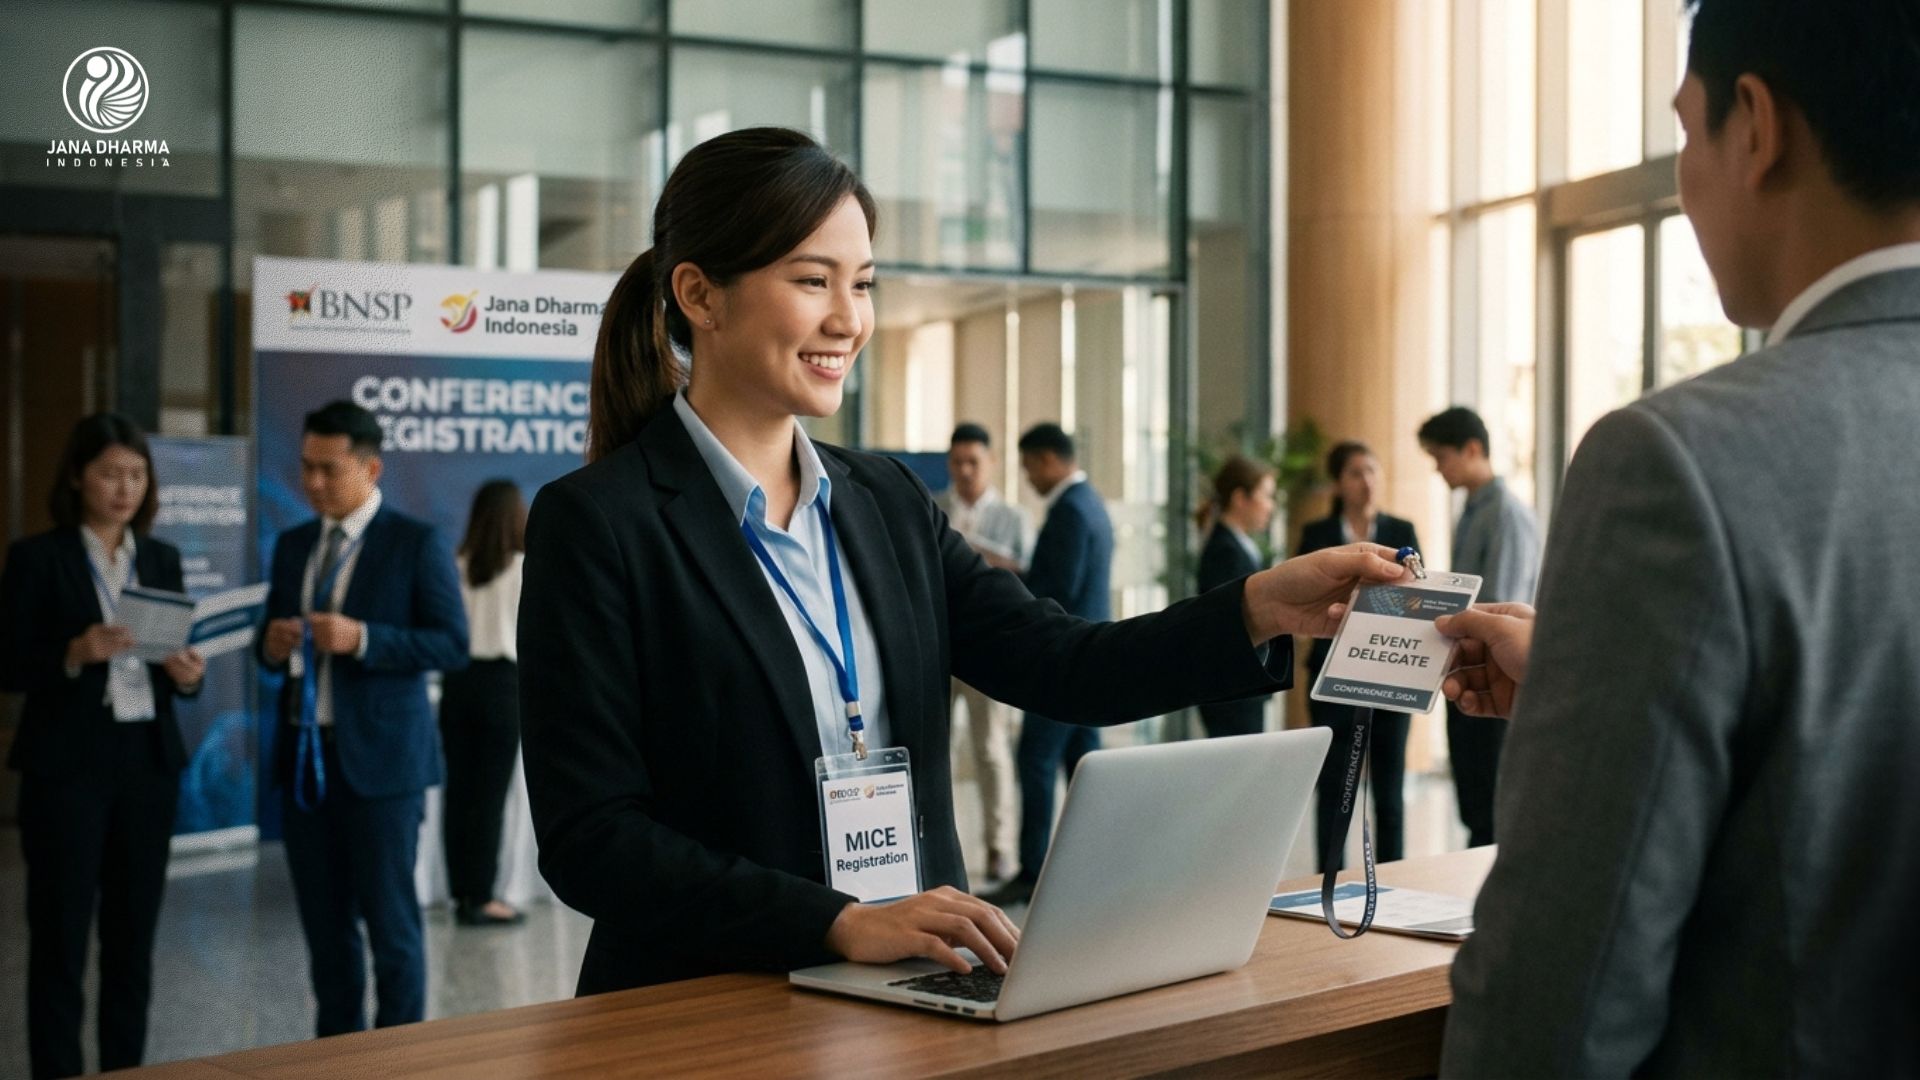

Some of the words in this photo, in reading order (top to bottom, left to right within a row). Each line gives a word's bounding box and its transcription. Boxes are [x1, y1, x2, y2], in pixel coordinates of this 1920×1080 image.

[321, 290, 413, 320] BNSP
[485, 296, 530, 313] Jana
[486, 317, 578, 336] Indonesia
[353, 376, 590, 415] CONFERENC
[375, 414, 590, 453] EGISTRATIO
[1369, 633, 1422, 650] EVENT
[845, 826, 897, 852] MICE
[836, 852, 909, 873] Registration
